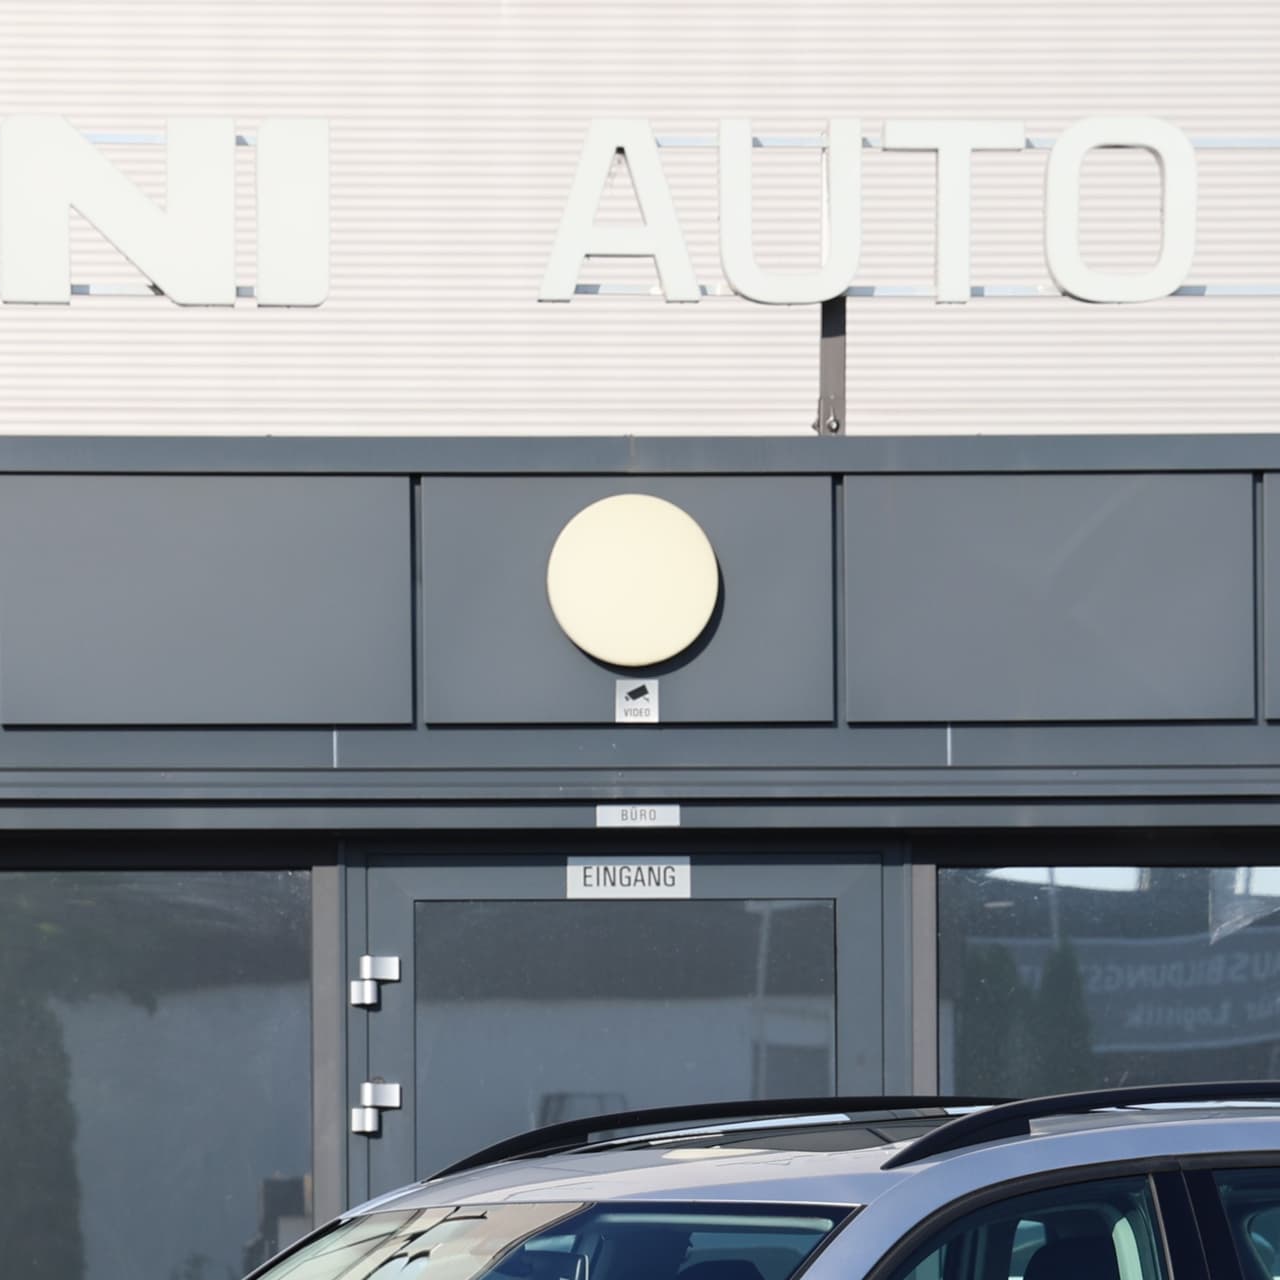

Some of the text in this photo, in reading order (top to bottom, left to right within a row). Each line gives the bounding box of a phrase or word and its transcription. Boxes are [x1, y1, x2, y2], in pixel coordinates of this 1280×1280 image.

[537, 114, 1198, 304] AUTO
[623, 707, 651, 718] VIDEO
[621, 806, 657, 821] BÜRO
[583, 865, 676, 887] EINGANG
